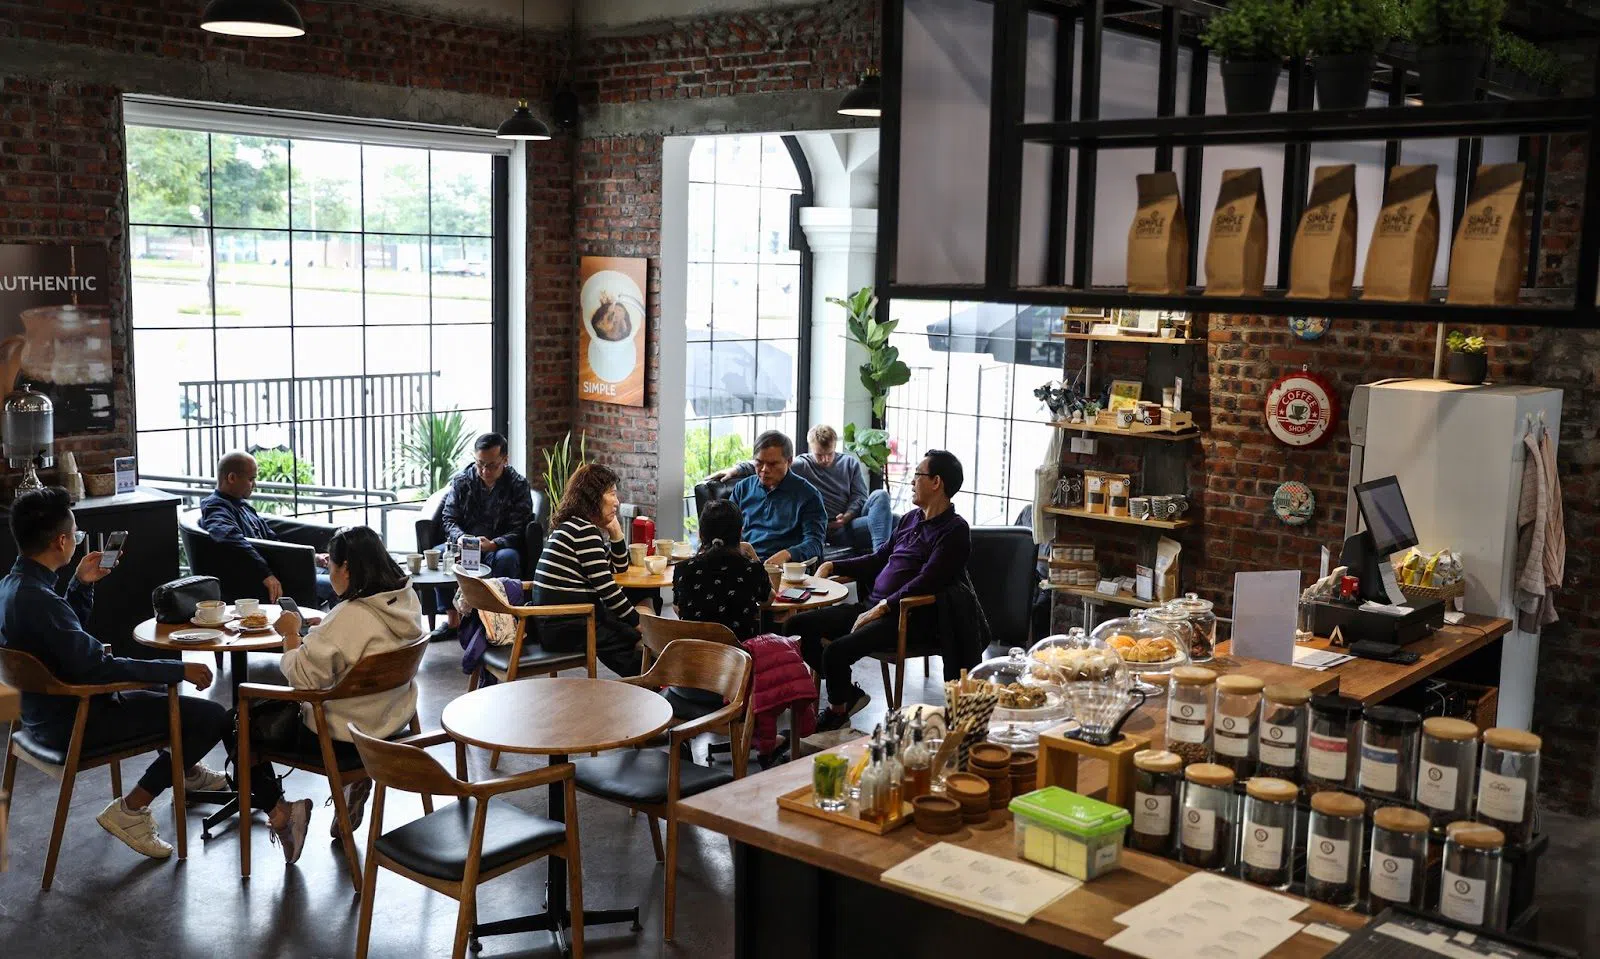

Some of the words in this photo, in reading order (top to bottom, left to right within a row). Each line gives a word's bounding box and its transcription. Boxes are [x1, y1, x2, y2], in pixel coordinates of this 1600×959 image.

[1137, 217, 1166, 229] SIMPLE
[1216, 215, 1245, 225] SIMPLE
[1306, 212, 1337, 224] SIMPLE
[1383, 213, 1415, 225] SIMPLE
[1468, 215, 1502, 227] SIMPLE
[0, 276, 97, 291] UTHENTIC
[583, 381, 616, 396] SIMPLE
[1281, 390, 1317, 408] COFFEE
